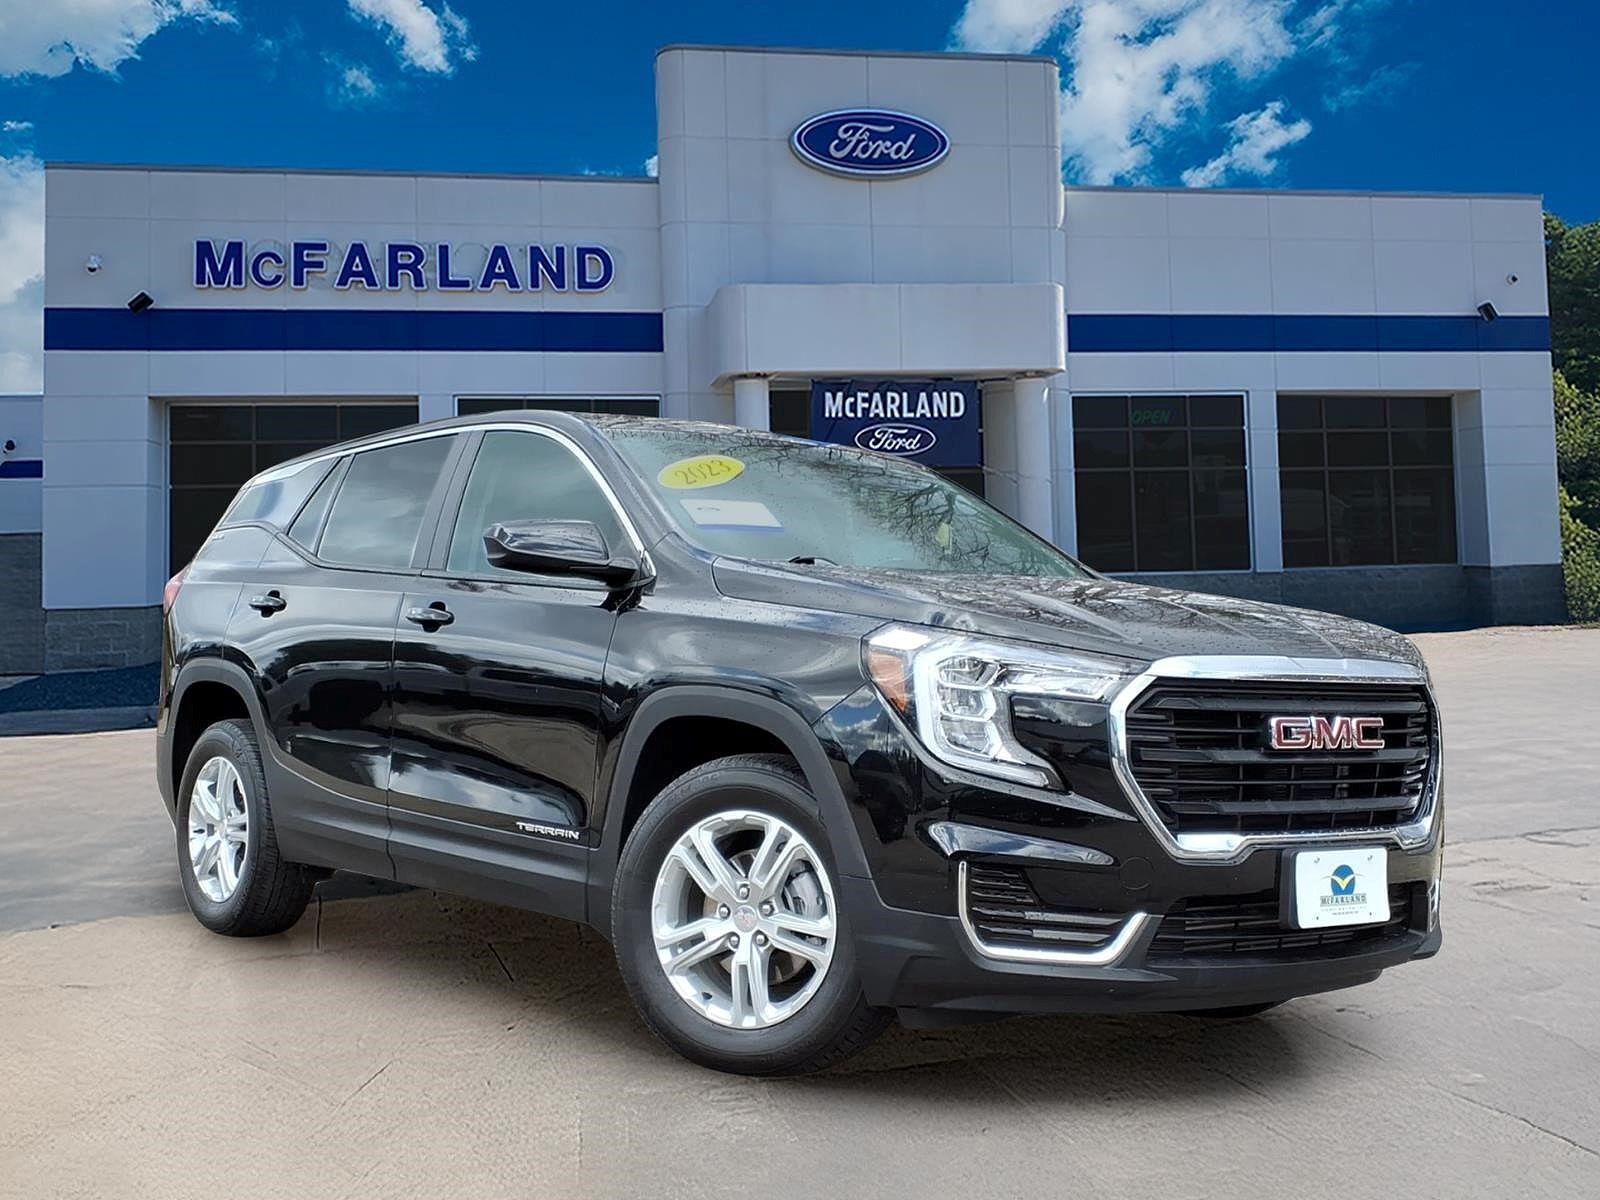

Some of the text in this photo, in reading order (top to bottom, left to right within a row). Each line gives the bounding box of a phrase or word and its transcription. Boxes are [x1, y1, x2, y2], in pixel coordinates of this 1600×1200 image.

[829, 122, 916, 160] Ford
[193, 239, 615, 292] McFARLAND
[824, 391, 966, 418] McFARLAND
[1131, 409, 1171, 424] OPEN
[868, 427, 922, 450] Ford
[1270, 715, 1385, 749] GMC
[516, 821, 580, 840] TERRAIN
